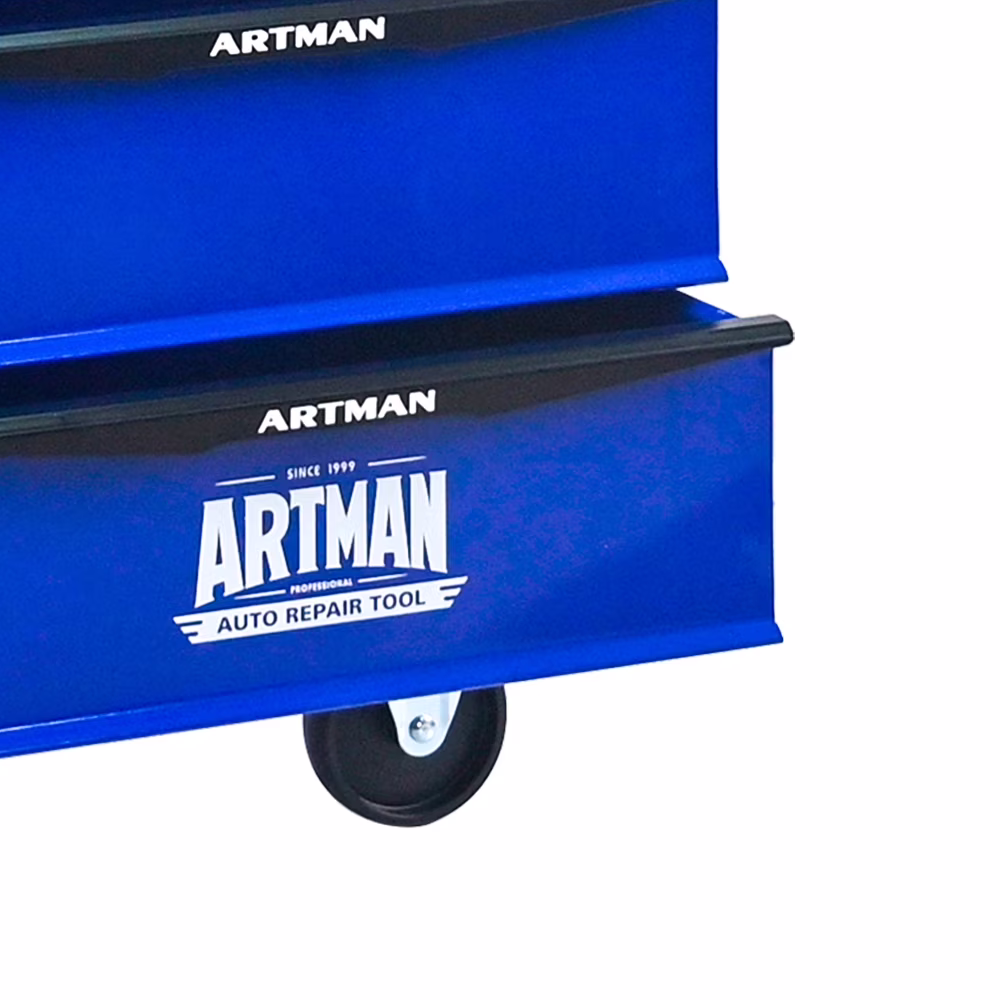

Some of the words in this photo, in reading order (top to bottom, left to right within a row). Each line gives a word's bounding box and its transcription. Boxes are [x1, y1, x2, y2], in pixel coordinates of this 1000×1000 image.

[209, 16, 385, 57] ARTMAN
[257, 388, 436, 433] ARTMAN
[286, 464, 321, 480] SINCE
[328, 460, 356, 474] 1999
[194, 469, 449, 609] ARTMAN
[290, 577, 353, 595] PROFESSIONAL
[217, 610, 278, 634] AUTO
[286, 598, 362, 624] REPAIR
[369, 589, 426, 612] TOOL
